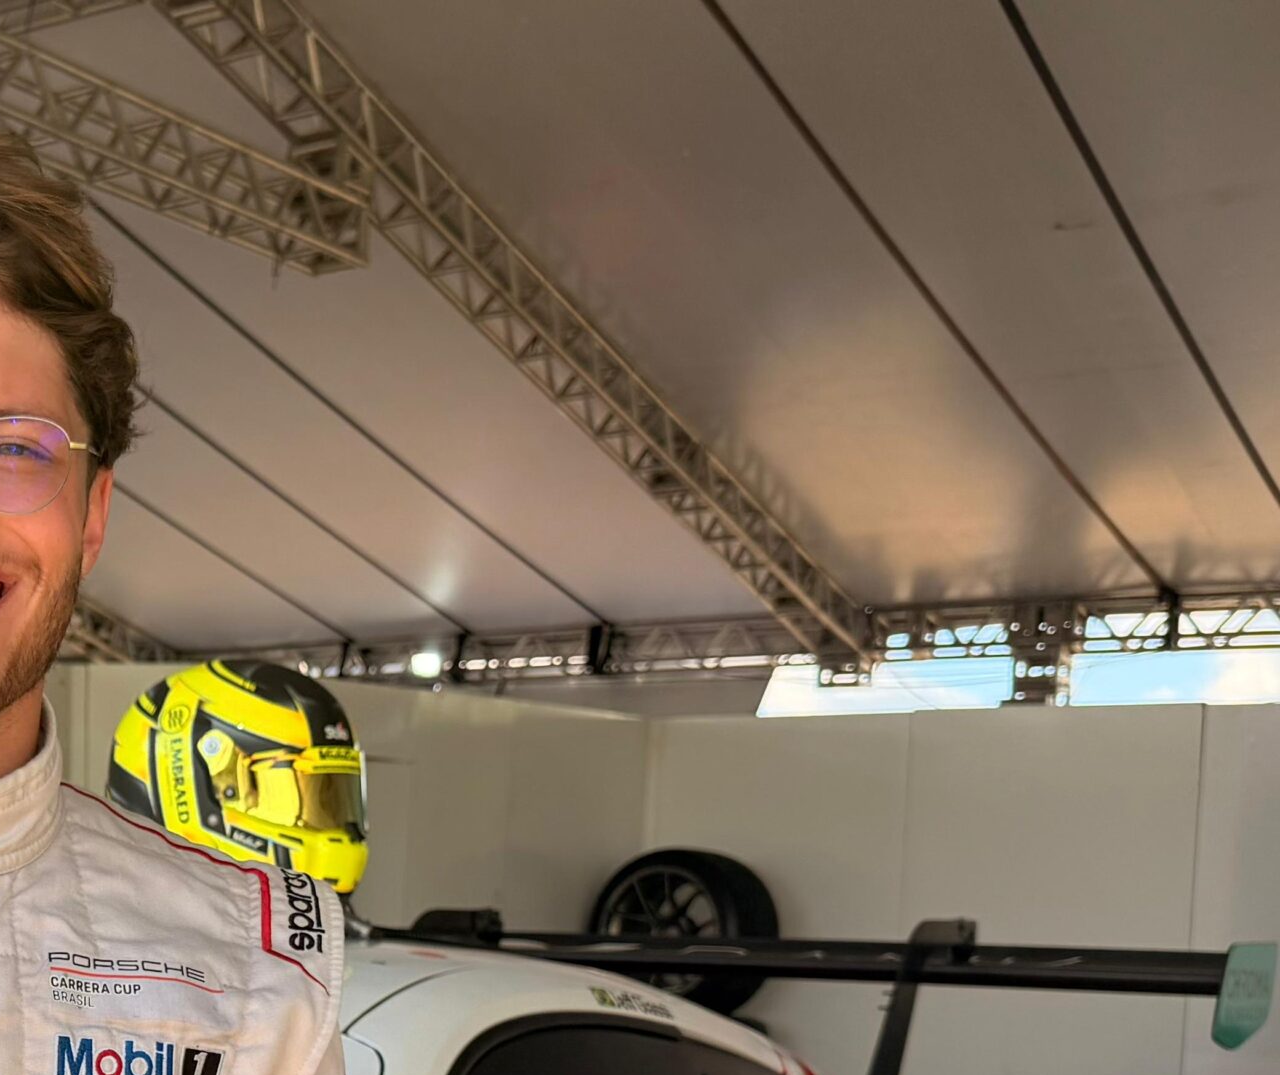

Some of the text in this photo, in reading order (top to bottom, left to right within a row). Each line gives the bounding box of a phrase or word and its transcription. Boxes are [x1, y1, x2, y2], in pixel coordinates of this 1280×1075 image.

[48, 952, 205, 983] PORSCHE
[50, 976, 141, 995] CARRERA CUP
[52, 990, 94, 1008] BRASIL
